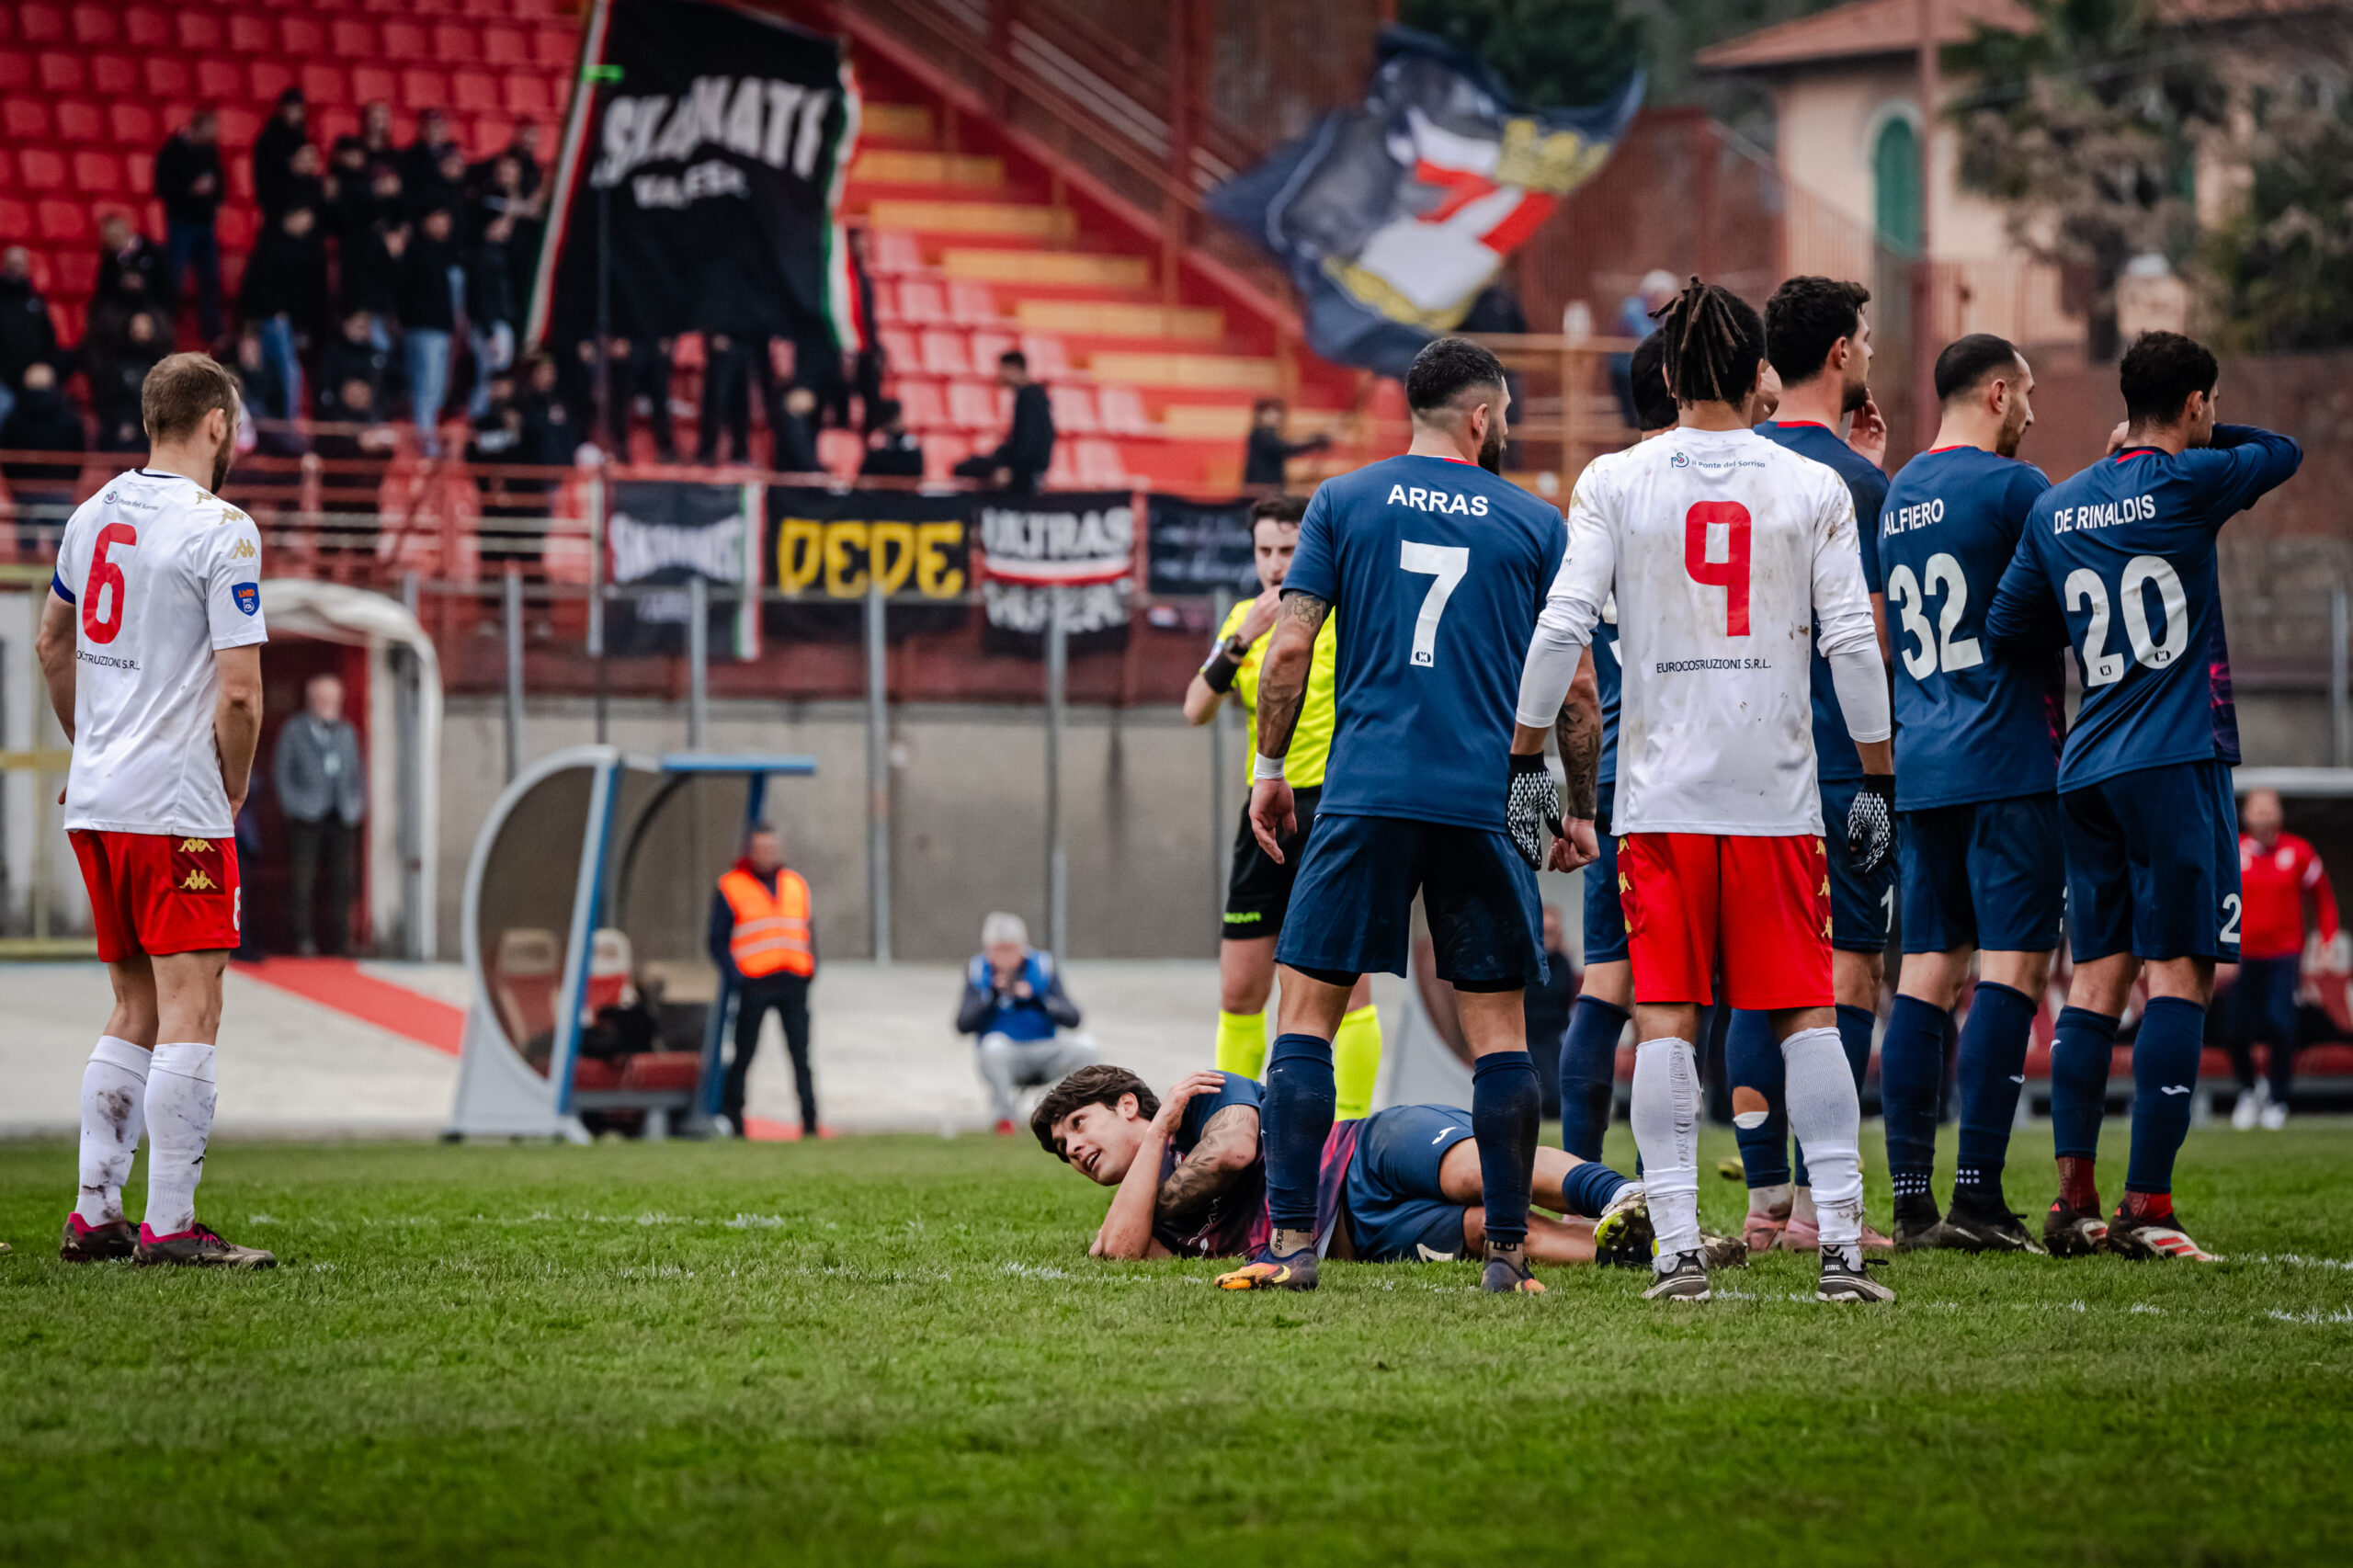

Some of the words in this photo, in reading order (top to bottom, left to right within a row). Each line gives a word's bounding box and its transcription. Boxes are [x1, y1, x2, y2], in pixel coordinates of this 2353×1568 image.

[1387, 483, 1489, 517] ARRAS
[1883, 497, 1945, 539] ALFIERO
[2054, 507, 2074, 535] DE
[2075, 494, 2156, 530] RINALDIS
[82, 522, 137, 644] 6
[1685, 500, 1752, 637] 9
[1400, 539, 1470, 667] 7
[1888, 552, 1984, 681] 32
[2064, 554, 2188, 687] 20
[1744, 658, 1772, 669] S.R.L.
[1881, 884, 1893, 934] 1
[1681, 1265, 1699, 1273] KING
[1824, 1264, 1841, 1272] KING
